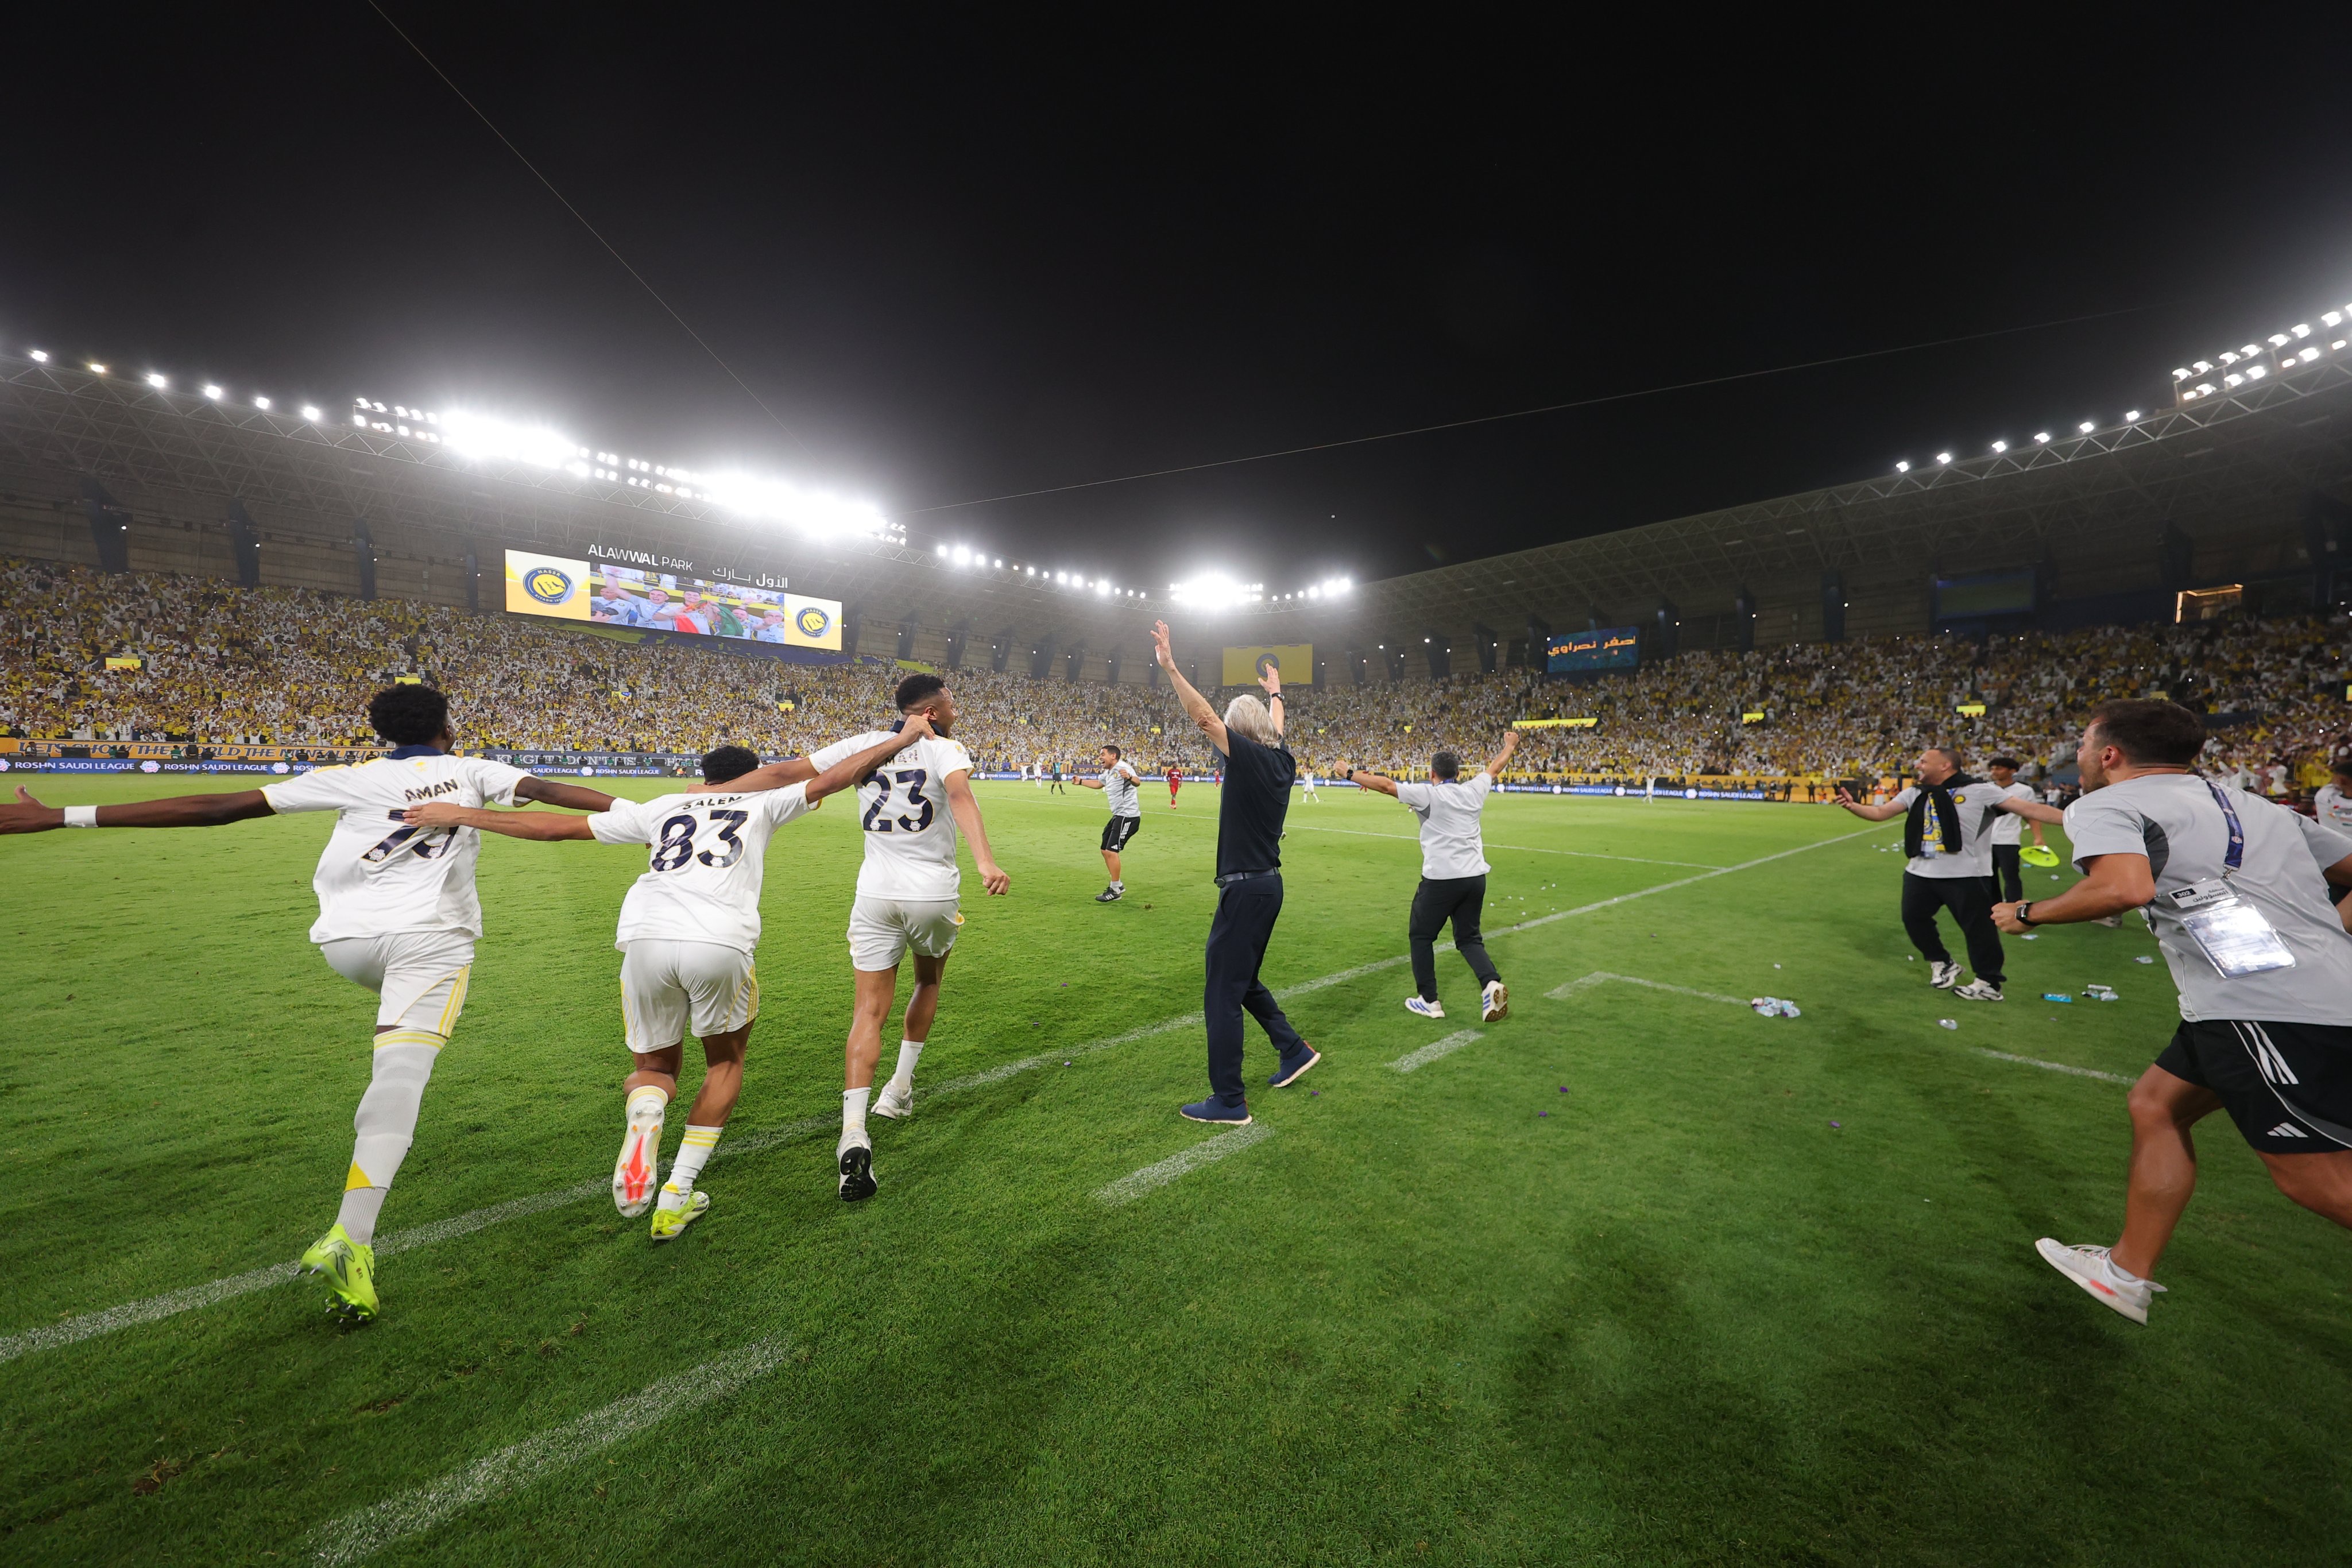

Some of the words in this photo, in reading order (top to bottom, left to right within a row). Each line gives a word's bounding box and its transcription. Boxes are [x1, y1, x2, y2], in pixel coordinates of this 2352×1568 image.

[588, 544, 659, 566] ALAWWAL
[662, 556, 693, 572] PARK
[537, 569, 561, 577] NASSR
[756, 573, 788, 589] الأول
[534, 594, 553, 602] RIYADH
[136, 745, 172, 754] THE
[243, 748, 276, 757] THE
[404, 779, 458, 802] AMAN
[682, 796, 742, 810] SALEM
[861, 768, 934, 833] 23
[651, 810, 749, 872] 83
[2176, 890, 2192, 898] 302
